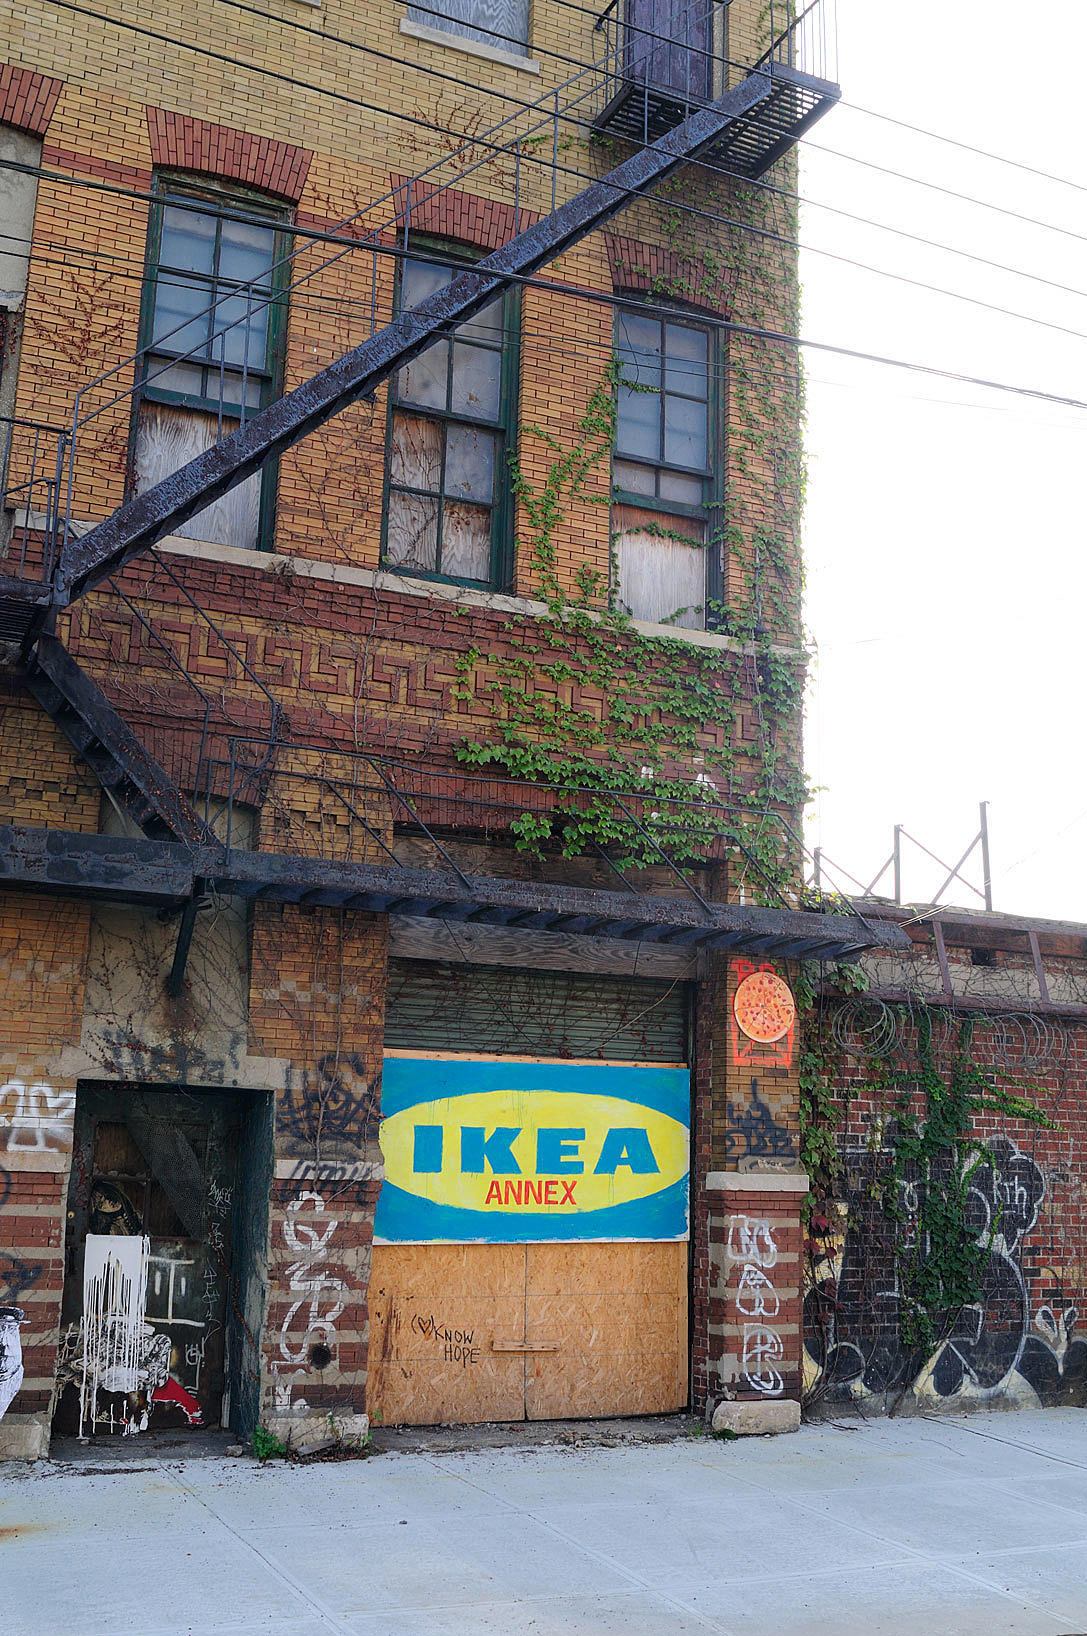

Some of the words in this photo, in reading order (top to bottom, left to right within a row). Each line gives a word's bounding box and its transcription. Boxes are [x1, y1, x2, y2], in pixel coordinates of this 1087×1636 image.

[413, 1125, 661, 1175] IKEA
[484, 1180, 577, 1205] ANNEX
[433, 1323, 474, 1344] KNOW
[444, 1343, 481, 1368] HOPE
